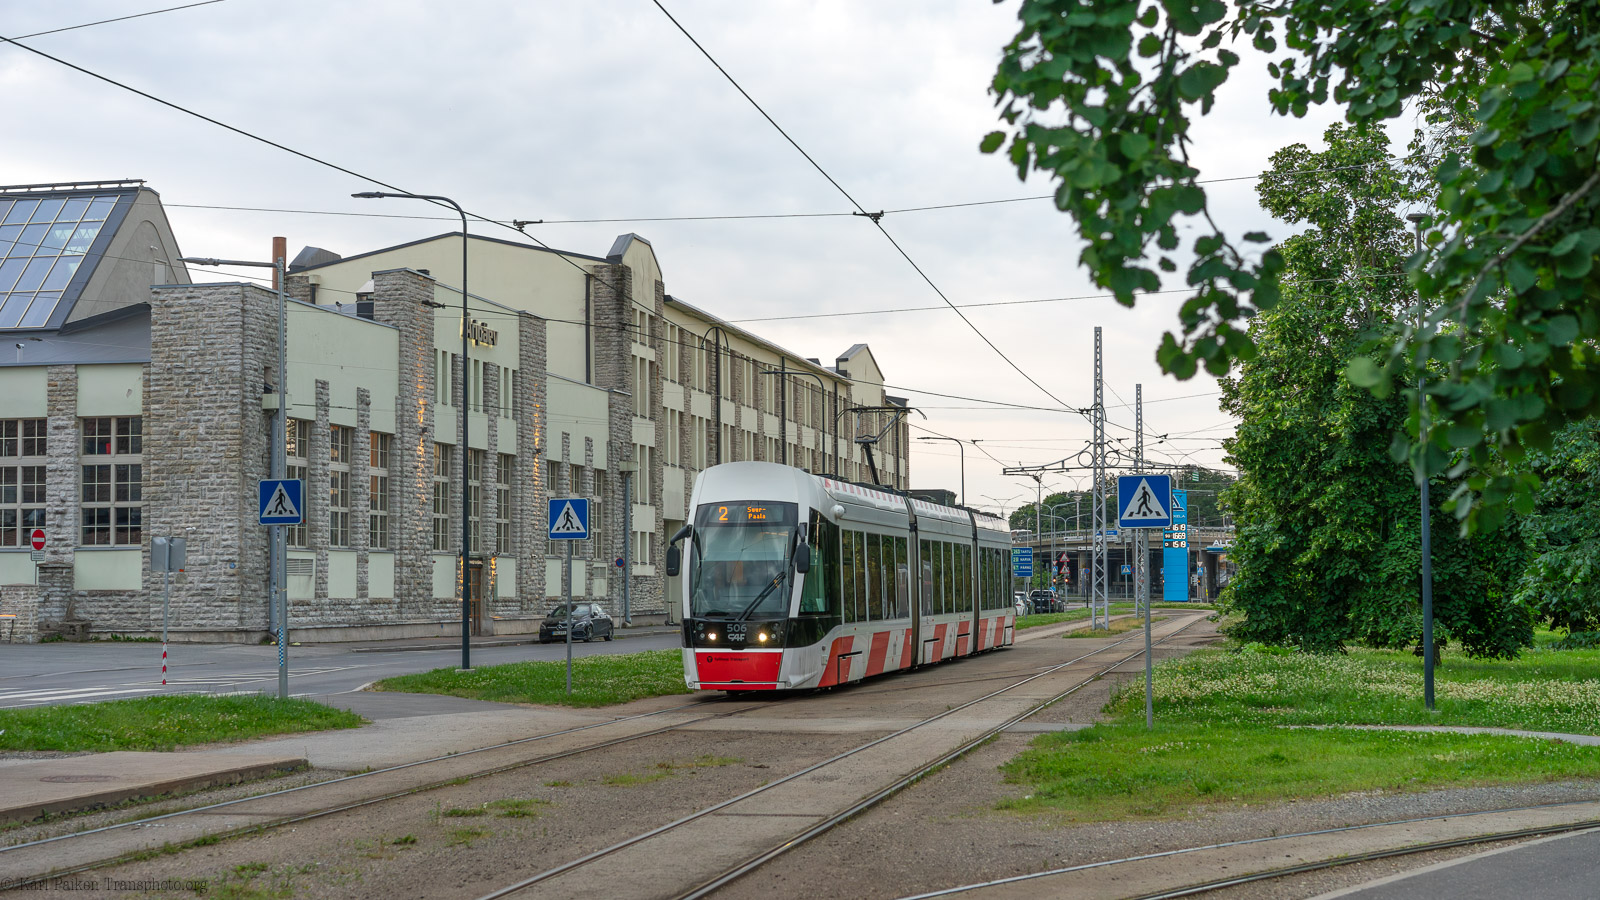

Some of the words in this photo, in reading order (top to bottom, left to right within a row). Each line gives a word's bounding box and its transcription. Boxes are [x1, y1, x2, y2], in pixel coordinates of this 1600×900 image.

[718, 506, 728, 521] 2
[727, 624, 748, 633] 506
[728, 633, 746, 642] CAF
